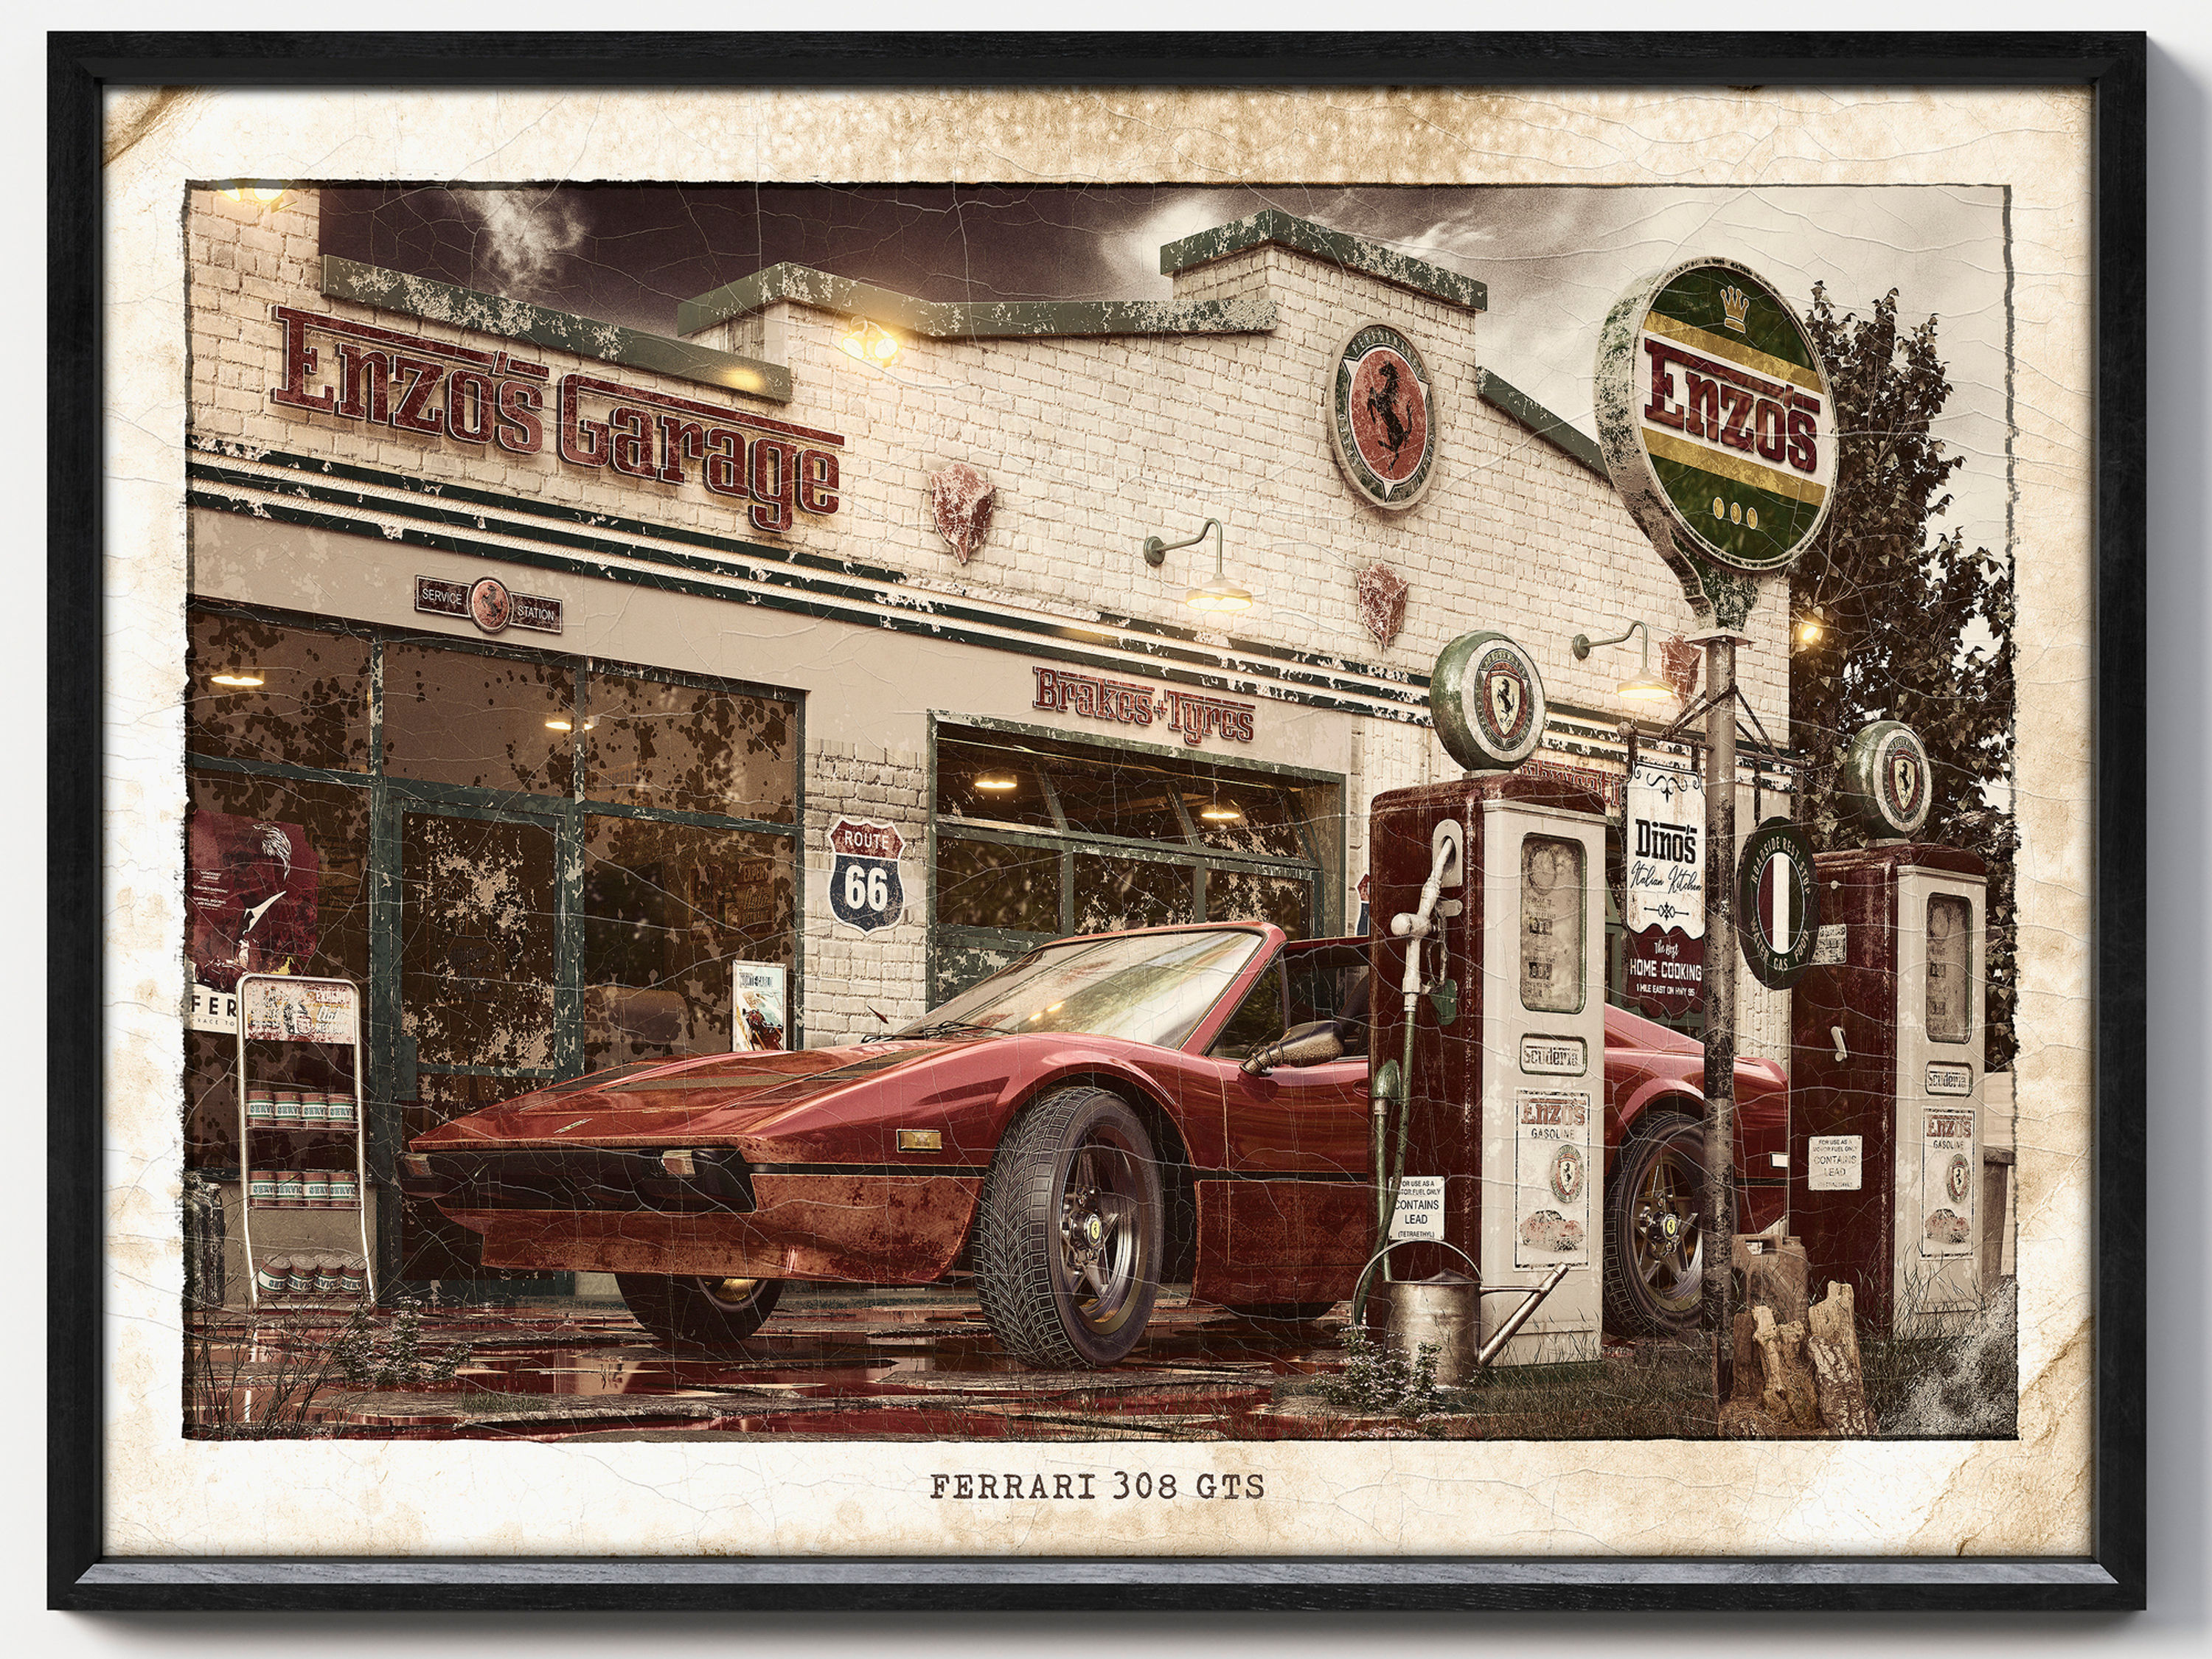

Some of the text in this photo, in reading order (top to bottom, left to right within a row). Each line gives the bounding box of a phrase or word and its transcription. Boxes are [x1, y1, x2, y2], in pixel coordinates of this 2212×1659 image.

[1644, 338, 1820, 473] Enzo's
[270, 305, 845, 534] Enzo's Garage
[1338, 414, 1359, 467] SPEED
[422, 588, 554, 622] SERVICE STATION
[844, 830, 890, 850] ROUTE
[1635, 818, 1697, 864] Dino's
[1750, 835, 1781, 884] ROADSIDE
[1782, 836, 1801, 861] REST
[844, 864, 888, 911] 66
[1630, 860, 1703, 894] Italian Kitchen
[1654, 939, 1665, 955] The
[1630, 959, 1703, 981] HOME COOKING
[1773, 958, 1789, 972] GAS
[1636, 984, 1640, 992] 1
[1640, 984, 1652, 993] MILE
[1652, 984, 1666, 994] EAST
[1666, 986, 1674, 995] ON
[1674, 987, 1687, 995] HWY
[191, 995, 236, 1017] FER
[1520, 1098, 1587, 1126] Enzo's
[1531, 1128, 1575, 1140] GASOLNE
[1933, 1140, 1964, 1150] GASOLNE
[1395, 1200, 1439, 1210] CONTAINS
[1405, 1214, 1428, 1224] LEAD
[930, 1471, 1265, 1500] FERRARI 308 GTS
